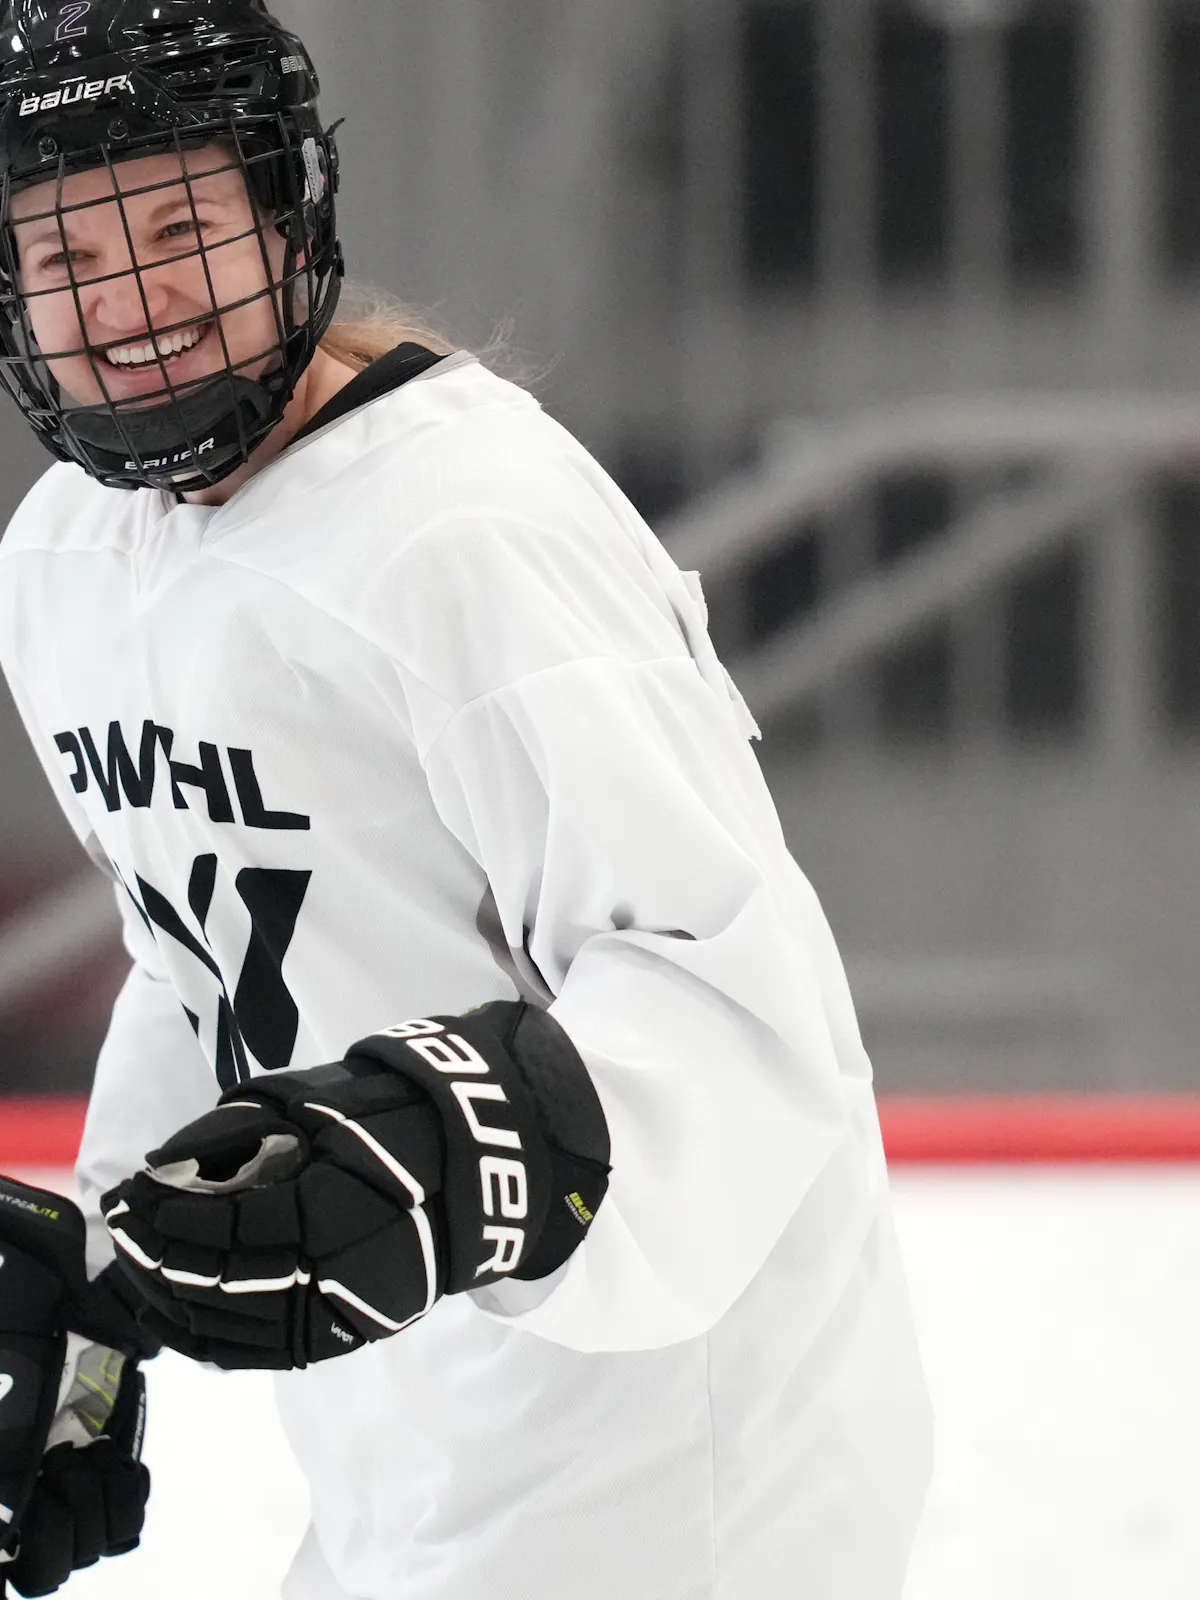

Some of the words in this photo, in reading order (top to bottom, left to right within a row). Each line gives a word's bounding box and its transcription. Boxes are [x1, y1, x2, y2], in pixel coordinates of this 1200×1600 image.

[55, 1, 90, 41] 2
[19, 74, 128, 117] BAUER
[376, 1018, 528, 1280] BAUER
